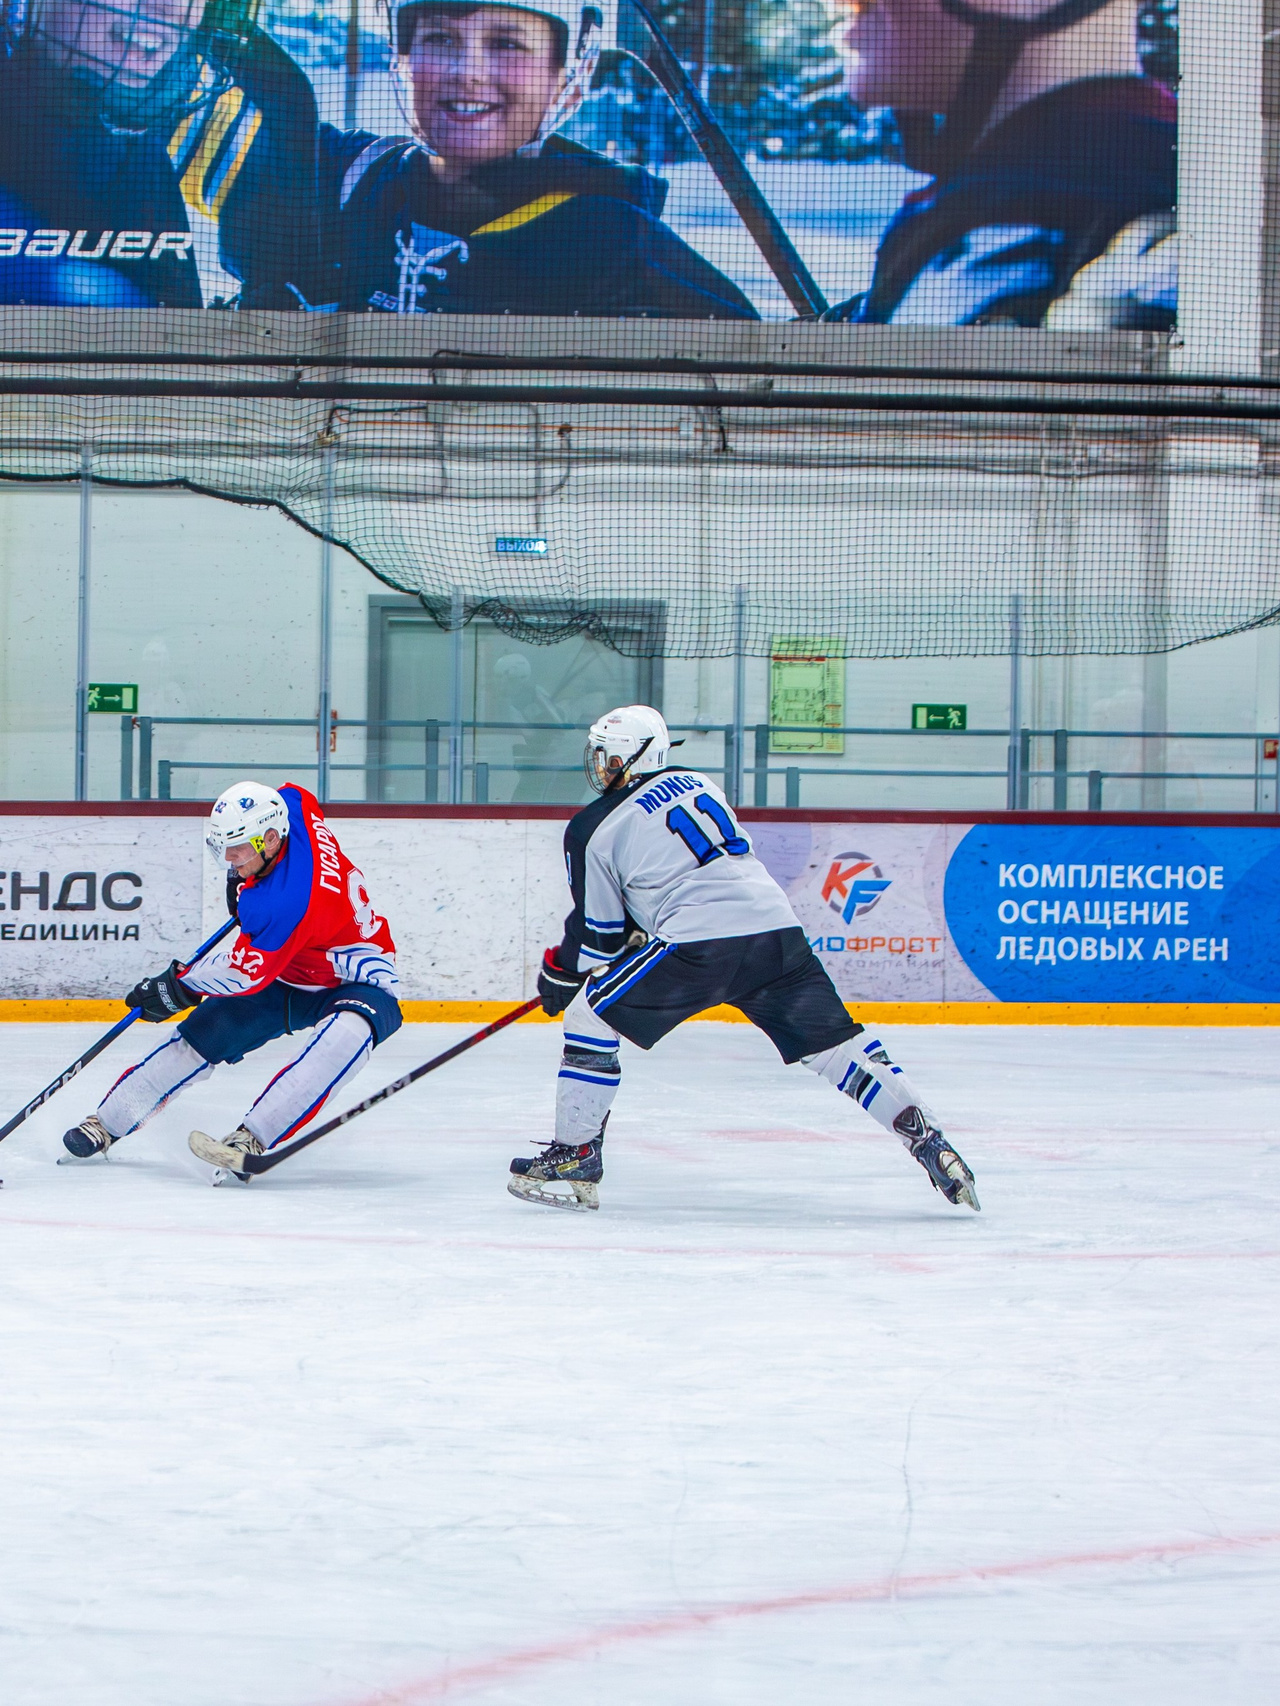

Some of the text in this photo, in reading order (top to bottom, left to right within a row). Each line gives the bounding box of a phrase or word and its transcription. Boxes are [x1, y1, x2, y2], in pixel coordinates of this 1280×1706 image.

[665, 792, 750, 868] 11
[998, 863, 1224, 890] КОМПЛЕКСНОЕ
[997, 900, 1189, 930] ОСНАЩЕНИЕ
[996, 937, 1229, 965] ЛЕДОВЫХ АРЕН
